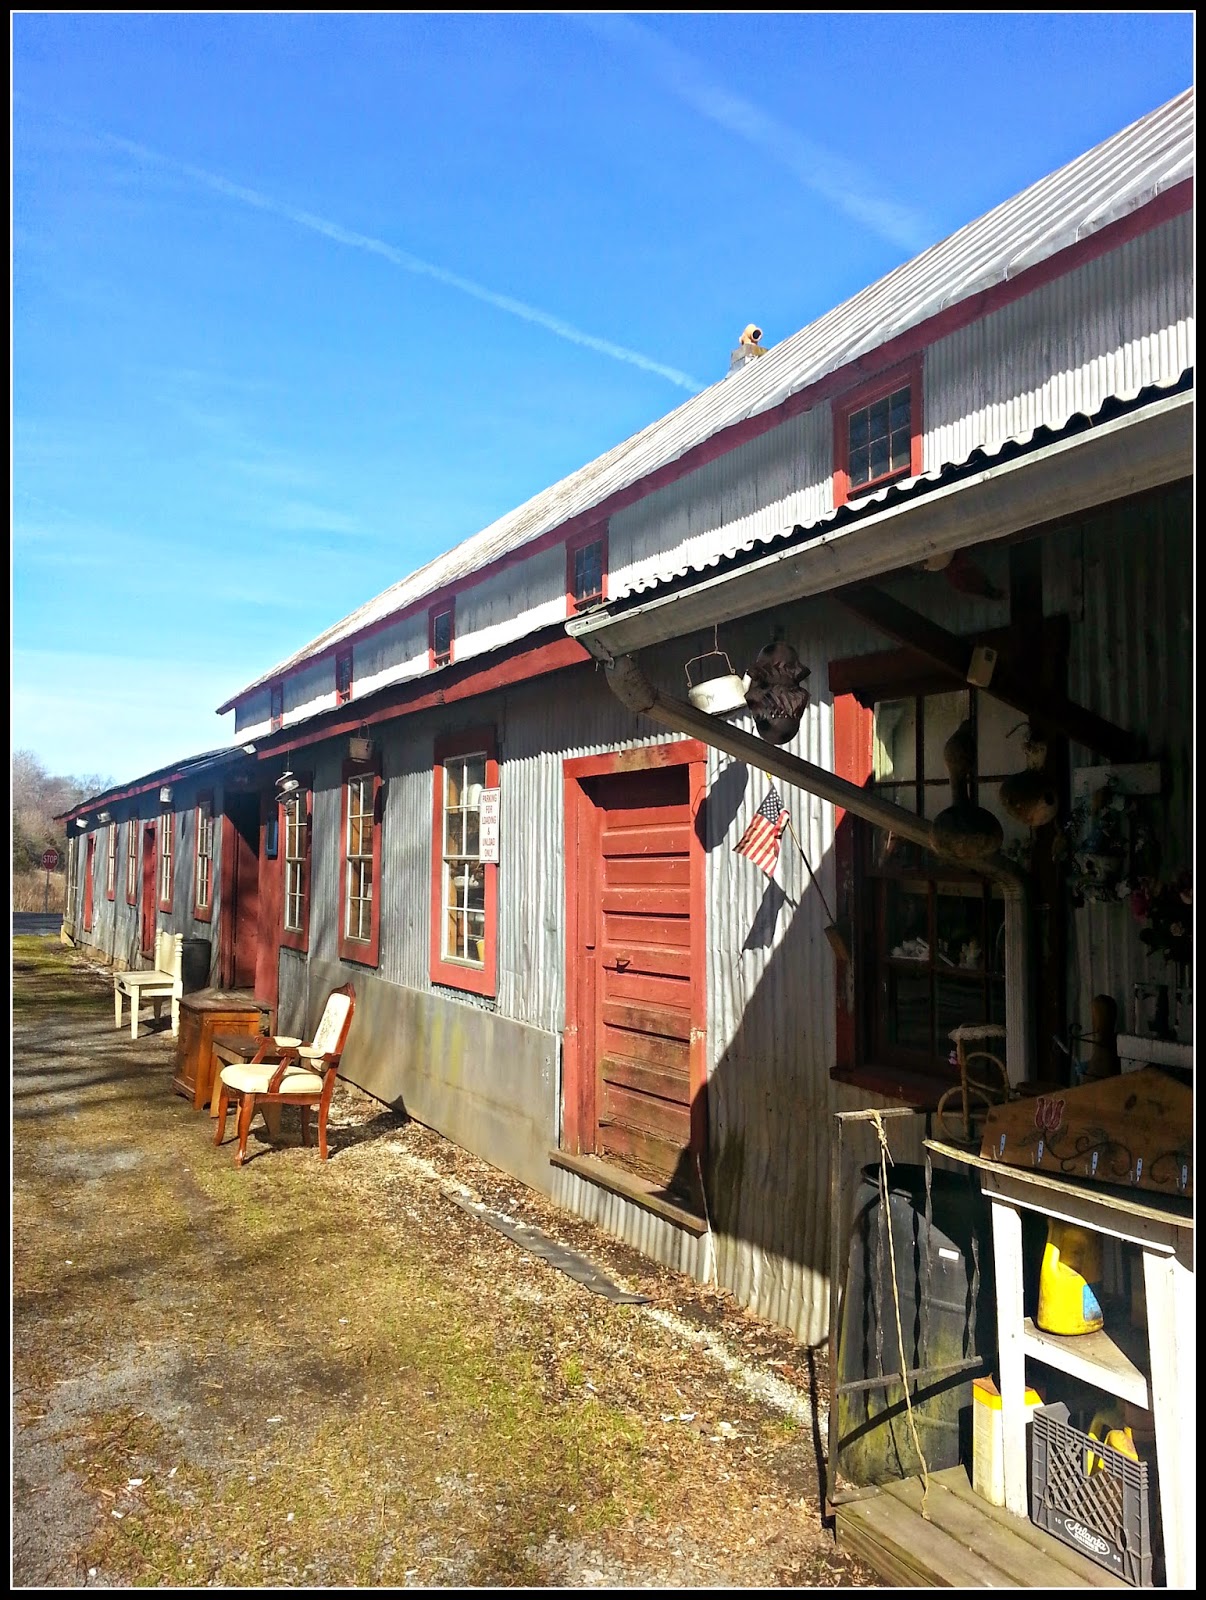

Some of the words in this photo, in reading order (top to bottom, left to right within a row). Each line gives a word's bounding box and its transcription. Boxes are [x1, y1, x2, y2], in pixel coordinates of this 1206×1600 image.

[482, 794, 497, 802] PARKING
[485, 805, 493, 814] FOR
[482, 815, 496, 824] LOADING
[482, 837, 496, 846] UNLOAD
[484, 849, 493, 857] ONLY
[43, 855, 57, 863] STOP
[1067, 1522, 1107, 1551] Atlanta
